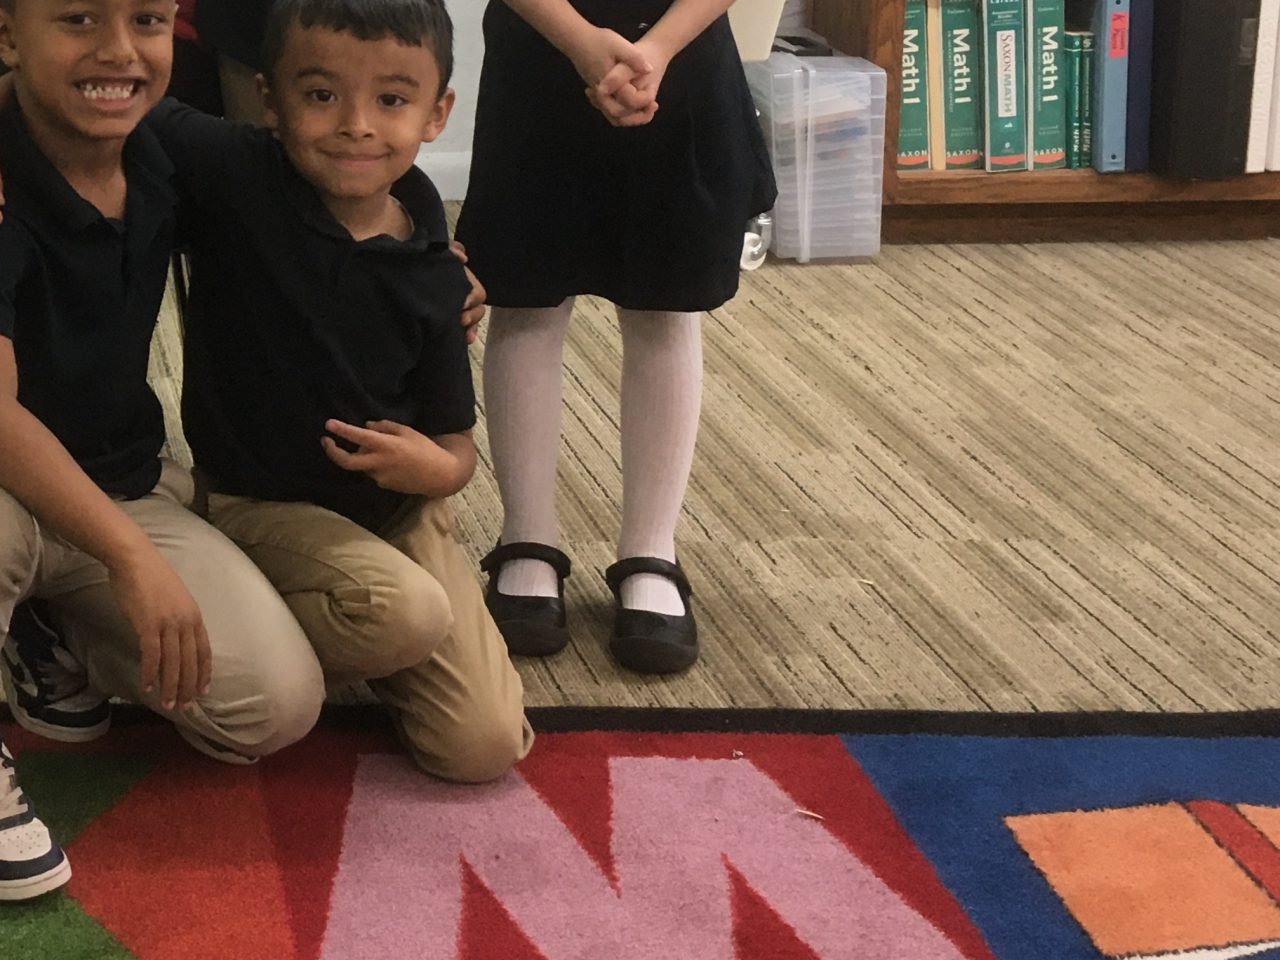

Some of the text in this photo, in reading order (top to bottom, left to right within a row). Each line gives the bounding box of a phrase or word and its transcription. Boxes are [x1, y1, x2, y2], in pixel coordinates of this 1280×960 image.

[903, 29, 920, 92] Math
[953, 28, 971, 92] Math
[999, 34, 1013, 72] SAXON
[1042, 26, 1058, 90] Math
